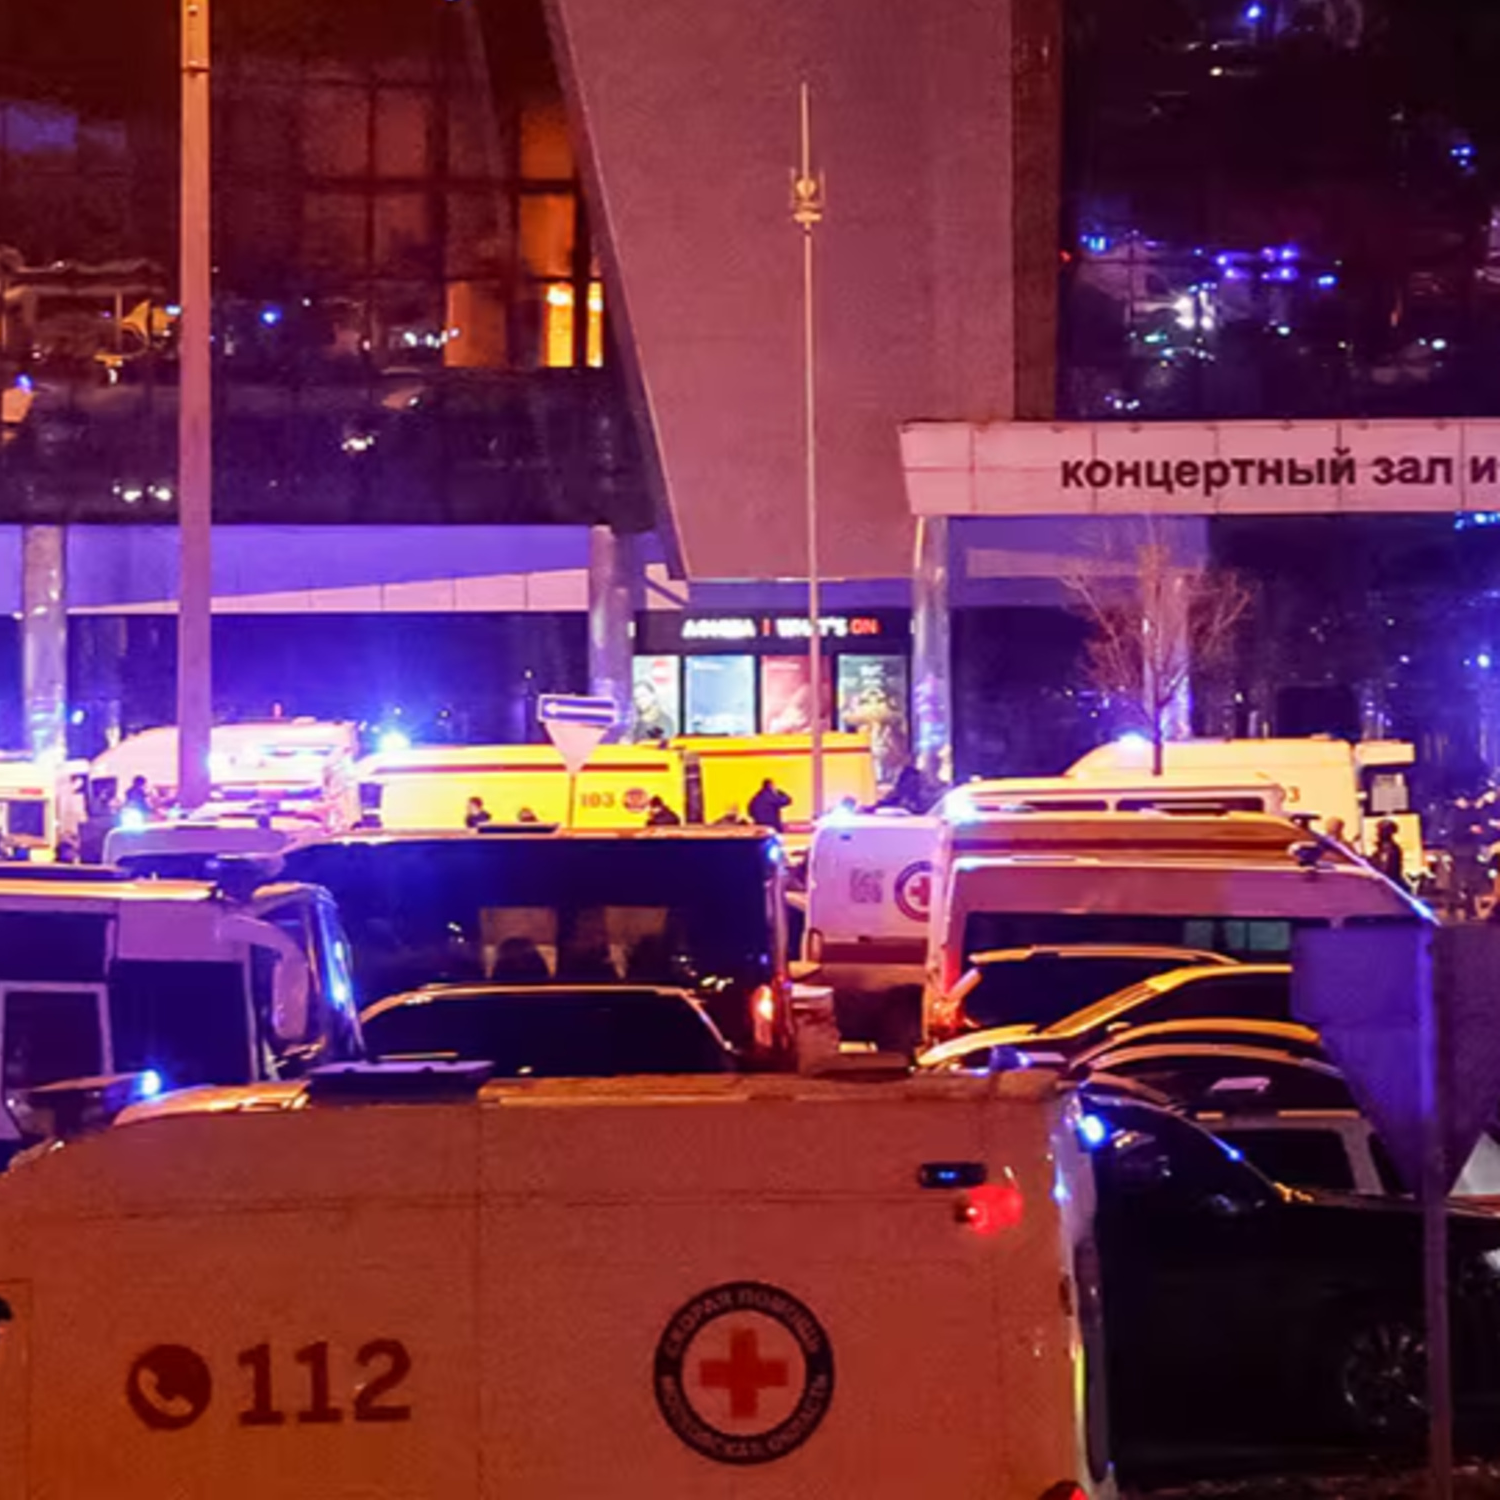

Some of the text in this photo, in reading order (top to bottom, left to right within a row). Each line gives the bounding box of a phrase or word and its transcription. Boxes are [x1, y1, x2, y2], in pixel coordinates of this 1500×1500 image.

[1061, 448, 1497, 497] концертный зал и
[850, 618, 877, 634] ON
[235, 1338, 413, 1427] 112
